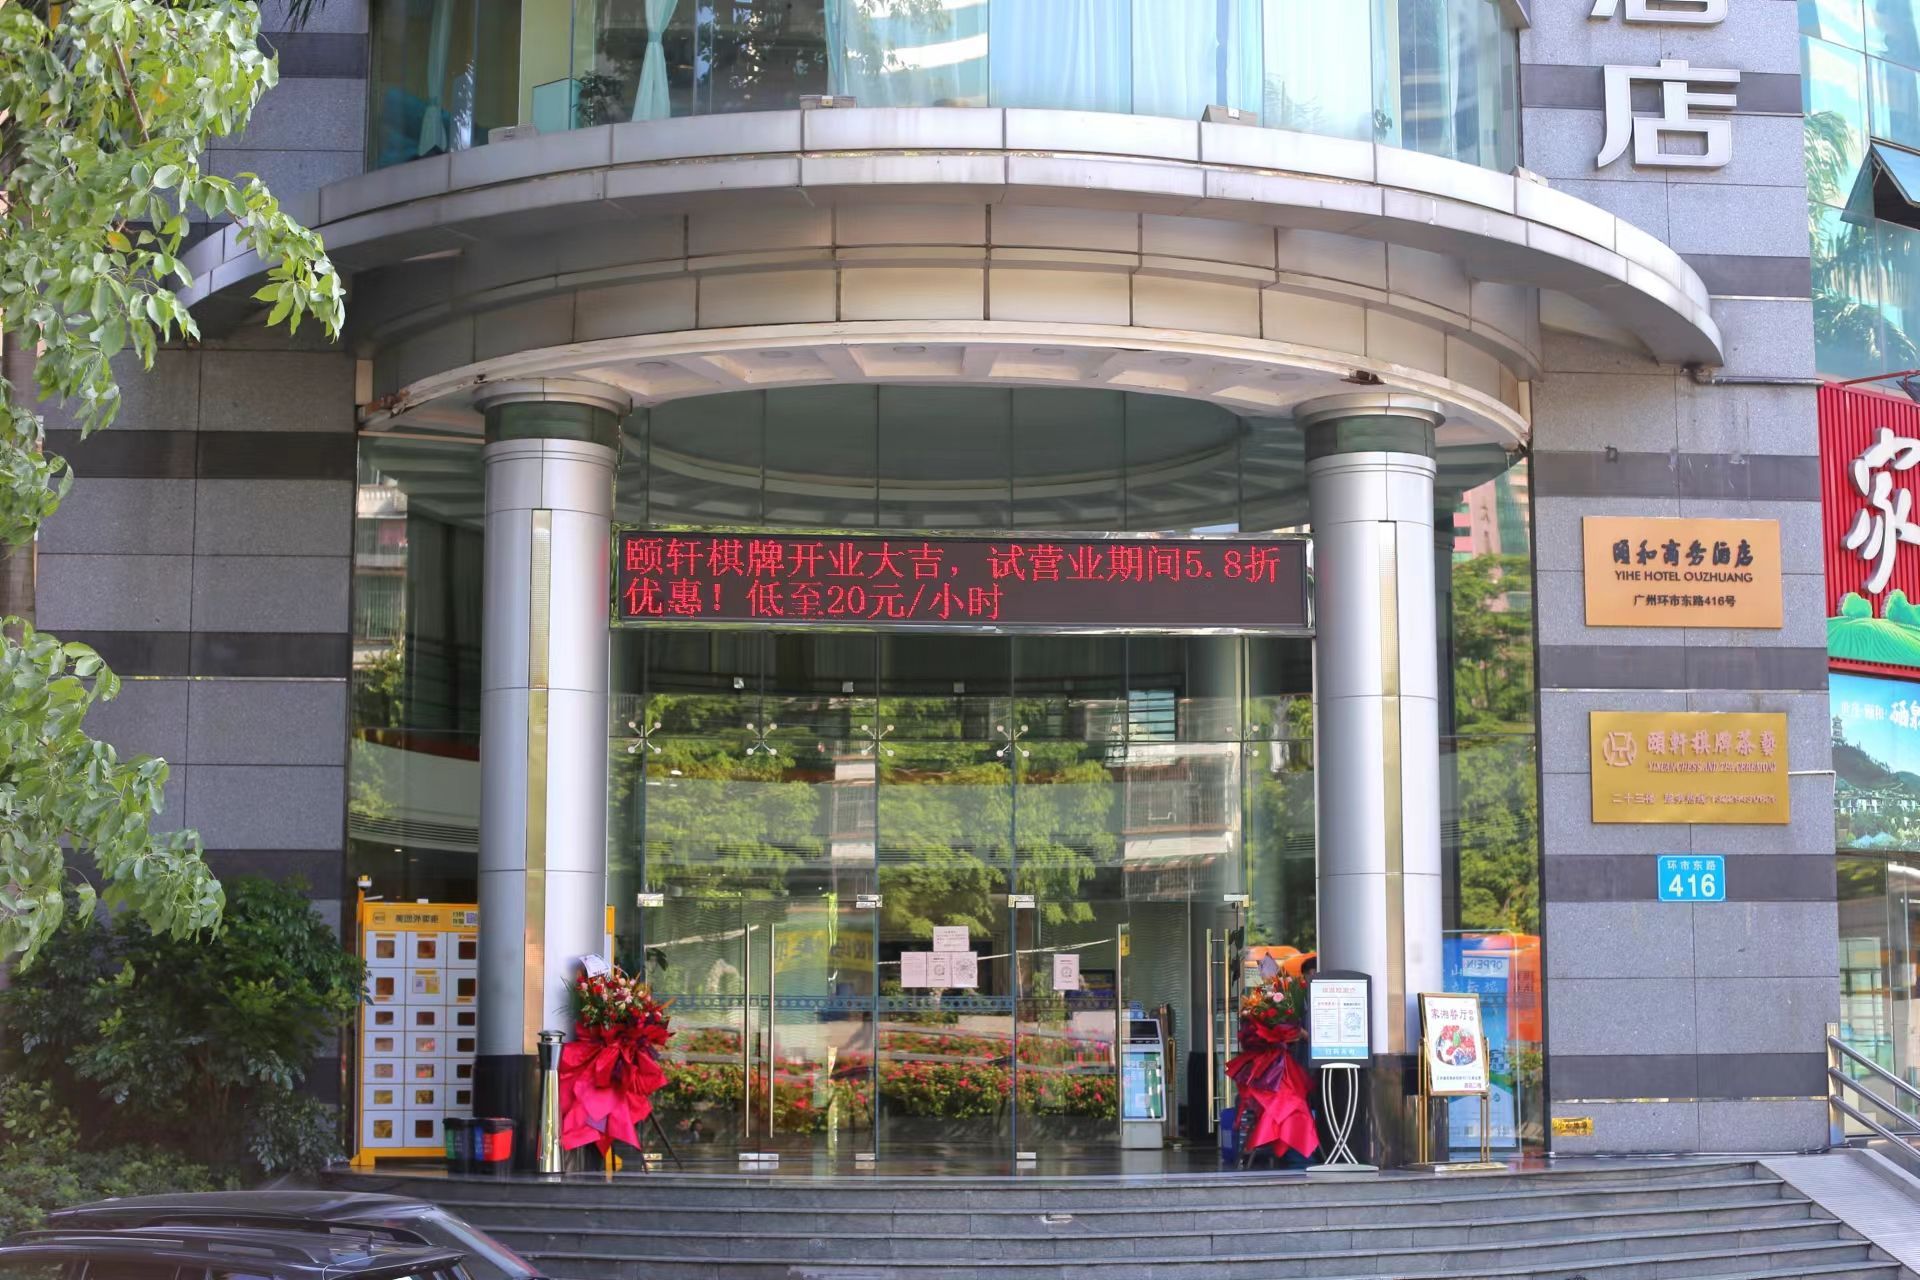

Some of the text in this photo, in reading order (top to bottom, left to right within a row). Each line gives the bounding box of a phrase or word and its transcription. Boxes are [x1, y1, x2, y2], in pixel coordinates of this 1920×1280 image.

[1591, 0, 1741, 168] 店
[1614, 569, 1753, 584] YIHE HOTEL OUZHUANG
[1633, 594, 1737, 608] 广州环市东路416号
[1667, 860, 1717, 871] 环市东路
[1668, 874, 1716, 897] 416
